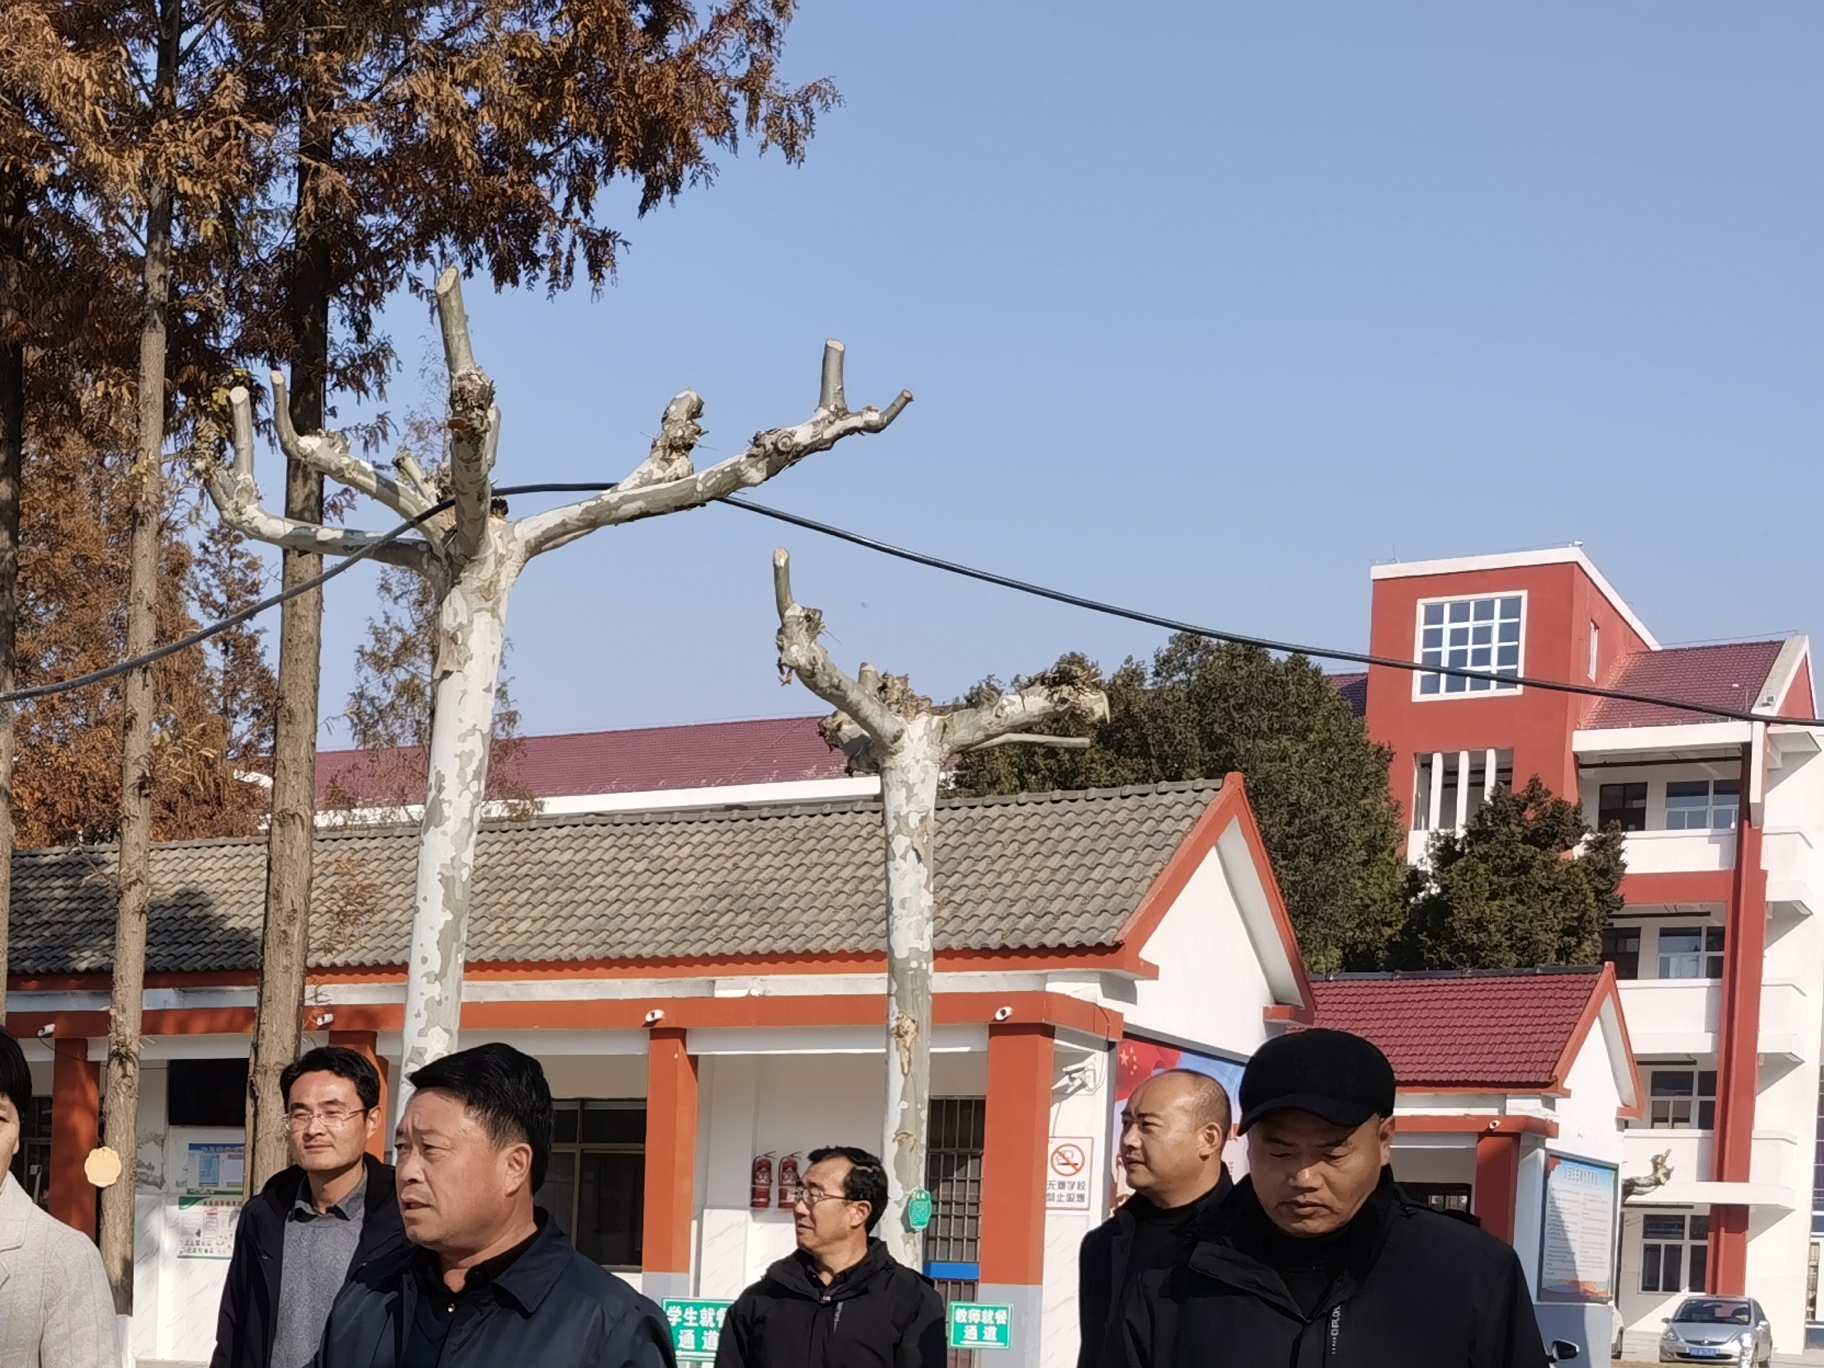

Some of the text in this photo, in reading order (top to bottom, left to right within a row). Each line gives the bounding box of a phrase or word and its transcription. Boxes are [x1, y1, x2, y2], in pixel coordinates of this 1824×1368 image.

[955, 1307, 1008, 1325] 教师就餐
[677, 1329, 720, 1351] 通道
[963, 1325, 998, 1341] 通道
